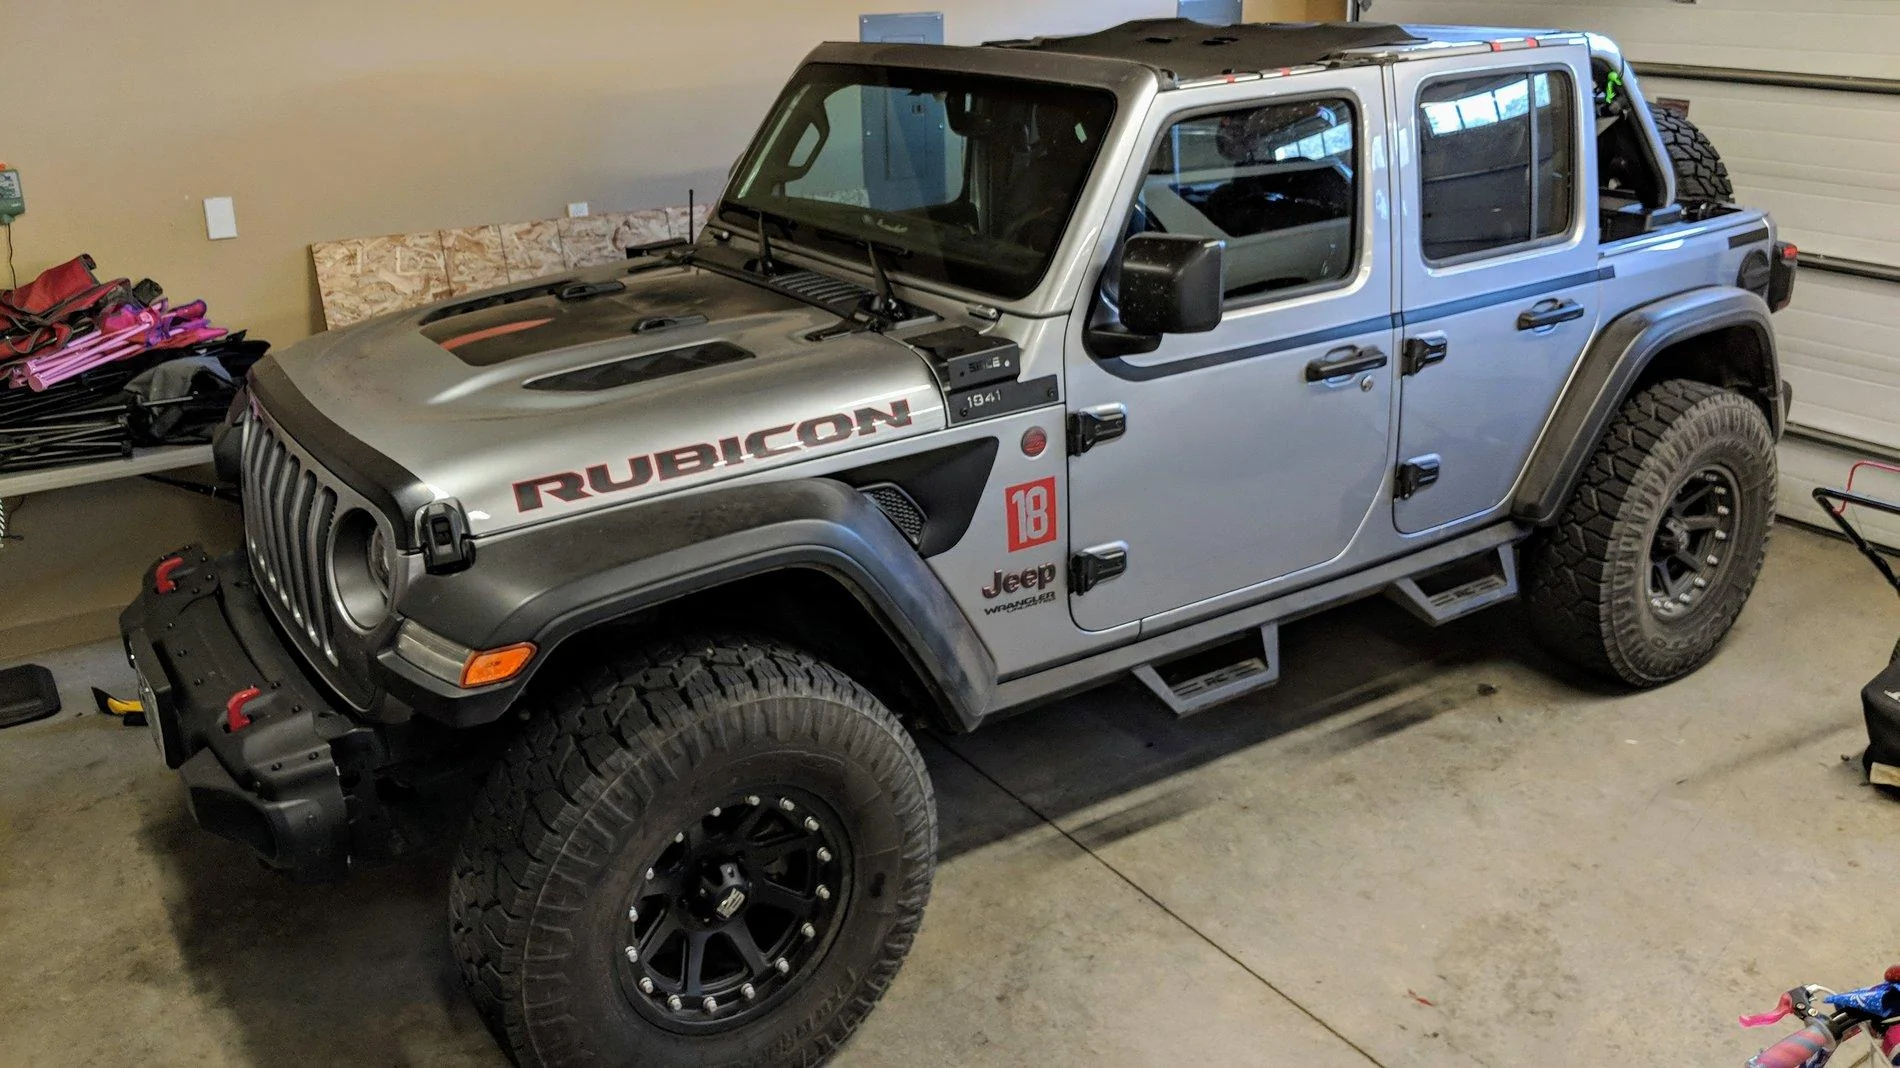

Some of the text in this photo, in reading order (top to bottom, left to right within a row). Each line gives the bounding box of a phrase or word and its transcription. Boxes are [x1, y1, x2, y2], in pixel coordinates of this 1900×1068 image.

[967, 389, 1001, 408] 1941
[512, 399, 912, 513] RUBICON
[1011, 485, 1049, 544] 18
[981, 561, 1057, 600] Jeep
[984, 591, 1056, 615] WRANGLER
